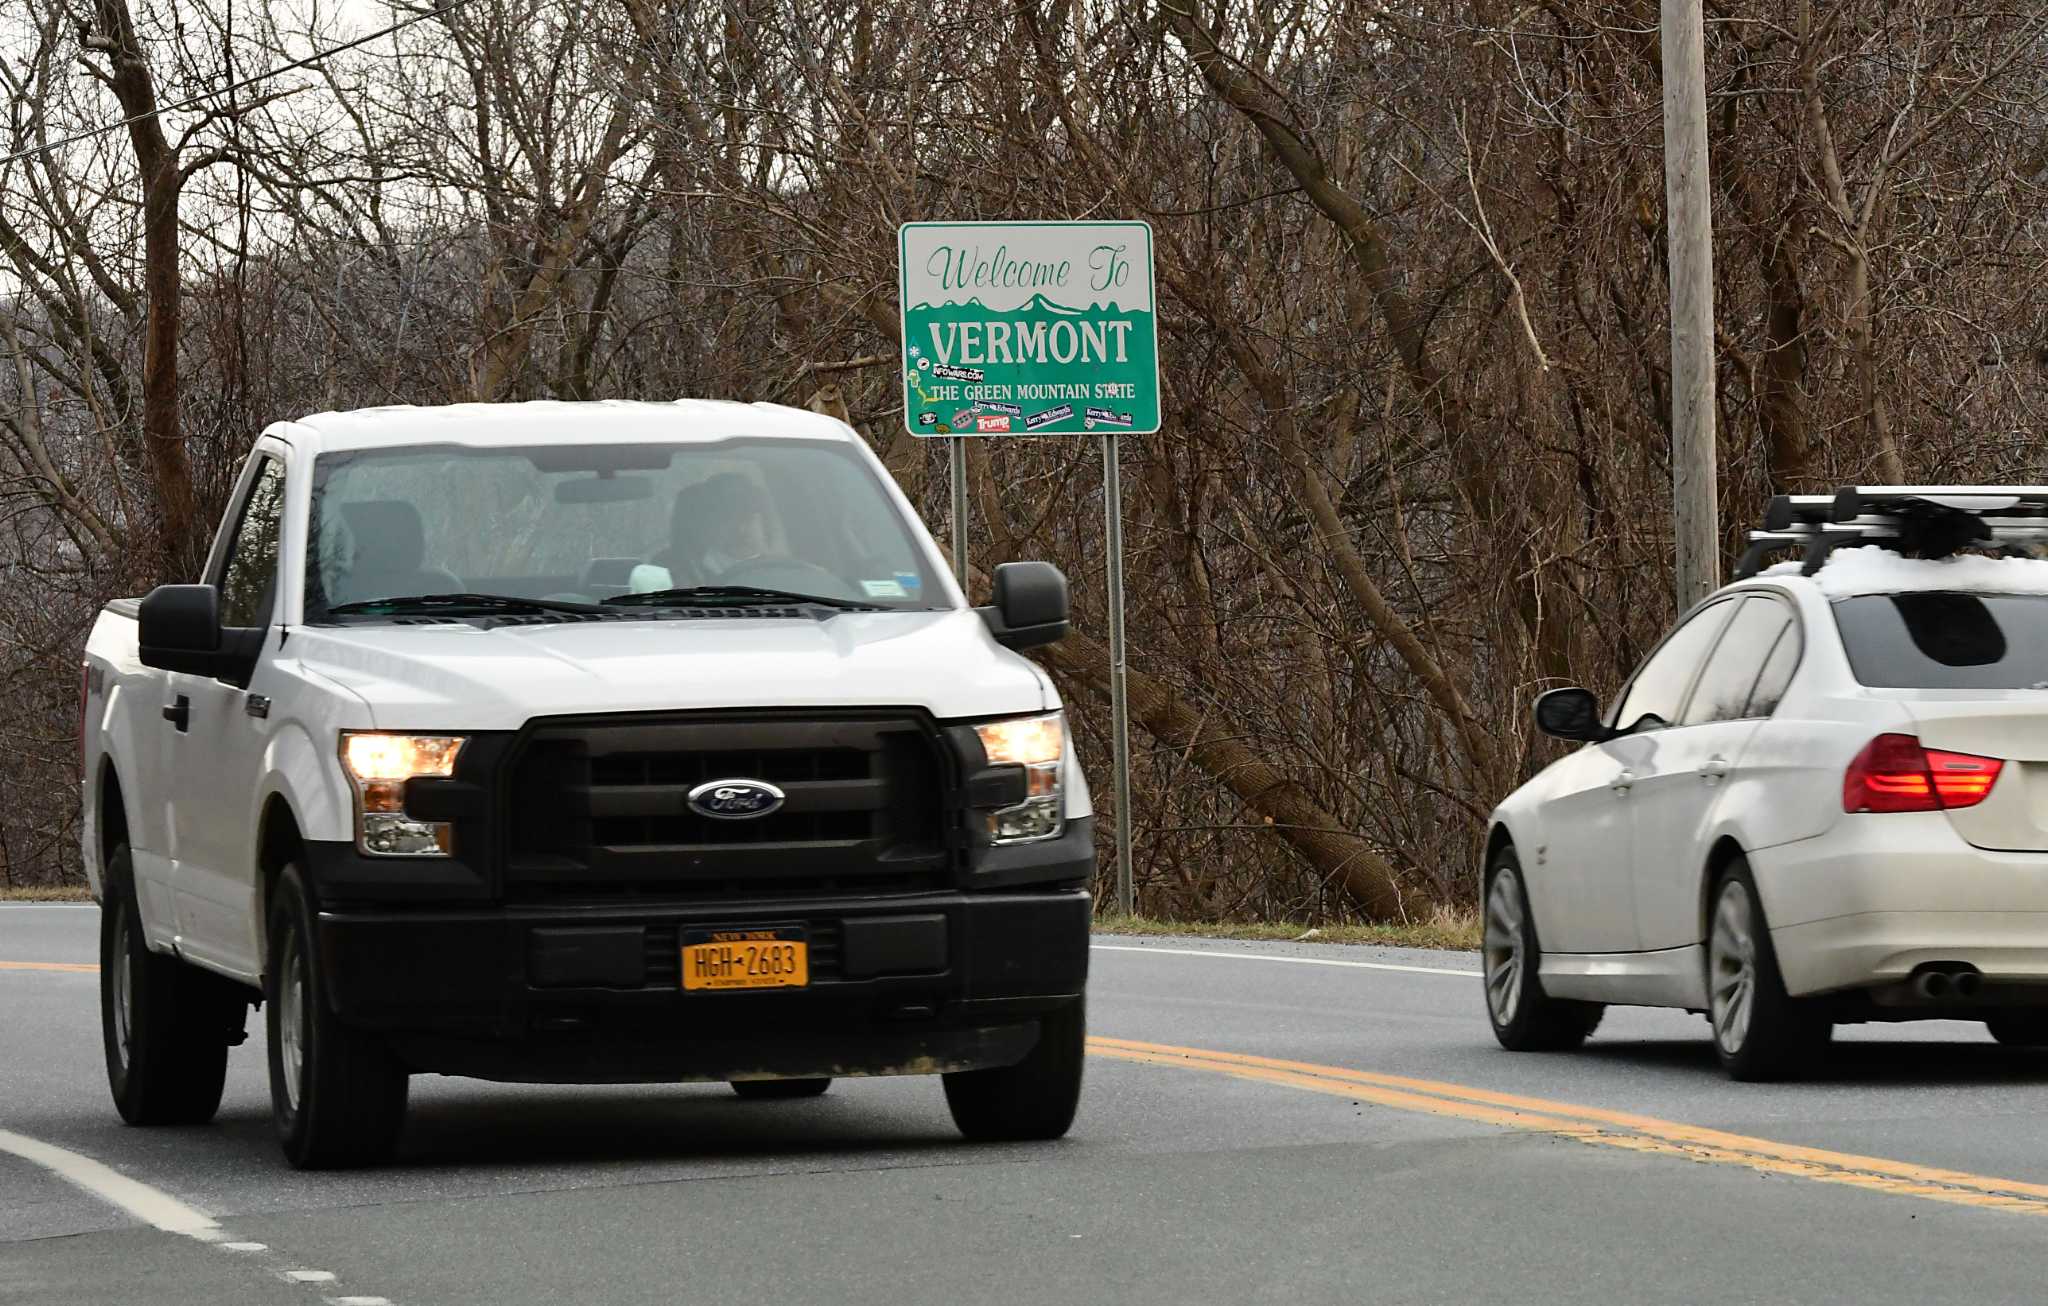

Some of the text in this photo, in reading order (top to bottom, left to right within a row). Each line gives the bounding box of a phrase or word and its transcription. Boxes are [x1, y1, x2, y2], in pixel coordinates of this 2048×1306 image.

[927, 245, 1130, 292] Welcome To
[928, 320, 1133, 364] VERMONT
[930, 385, 960, 400] THE
[964, 385, 1012, 400] GREEN
[1017, 384, 1090, 399] MOUNTAIN
[977, 416, 1010, 430] Trump
[746, 944, 796, 975] 2683
